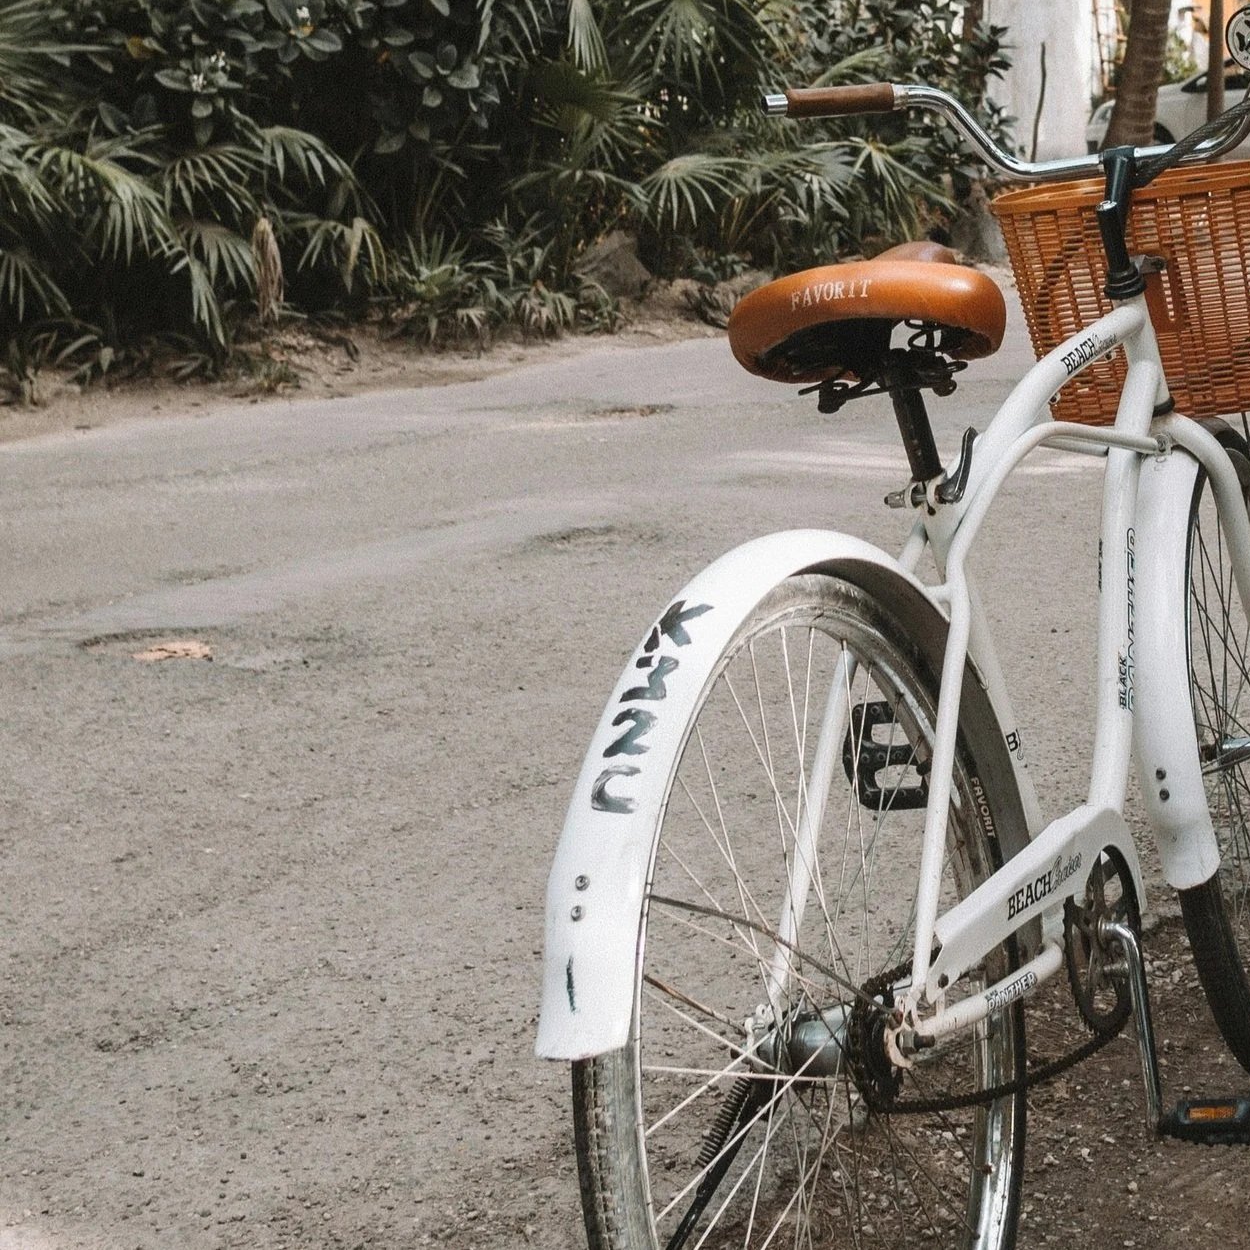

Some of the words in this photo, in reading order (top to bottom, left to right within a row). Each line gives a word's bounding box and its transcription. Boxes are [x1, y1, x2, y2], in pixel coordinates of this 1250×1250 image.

[790, 278, 872, 312] FAVORIT
[1060, 337, 1095, 376] BEACH
[1117, 655, 1128, 711] BLACK
[971, 776, 996, 838] FAVORIT
[1008, 870, 1053, 921] BEACH
[987, 971, 1037, 1012] PANTHER
